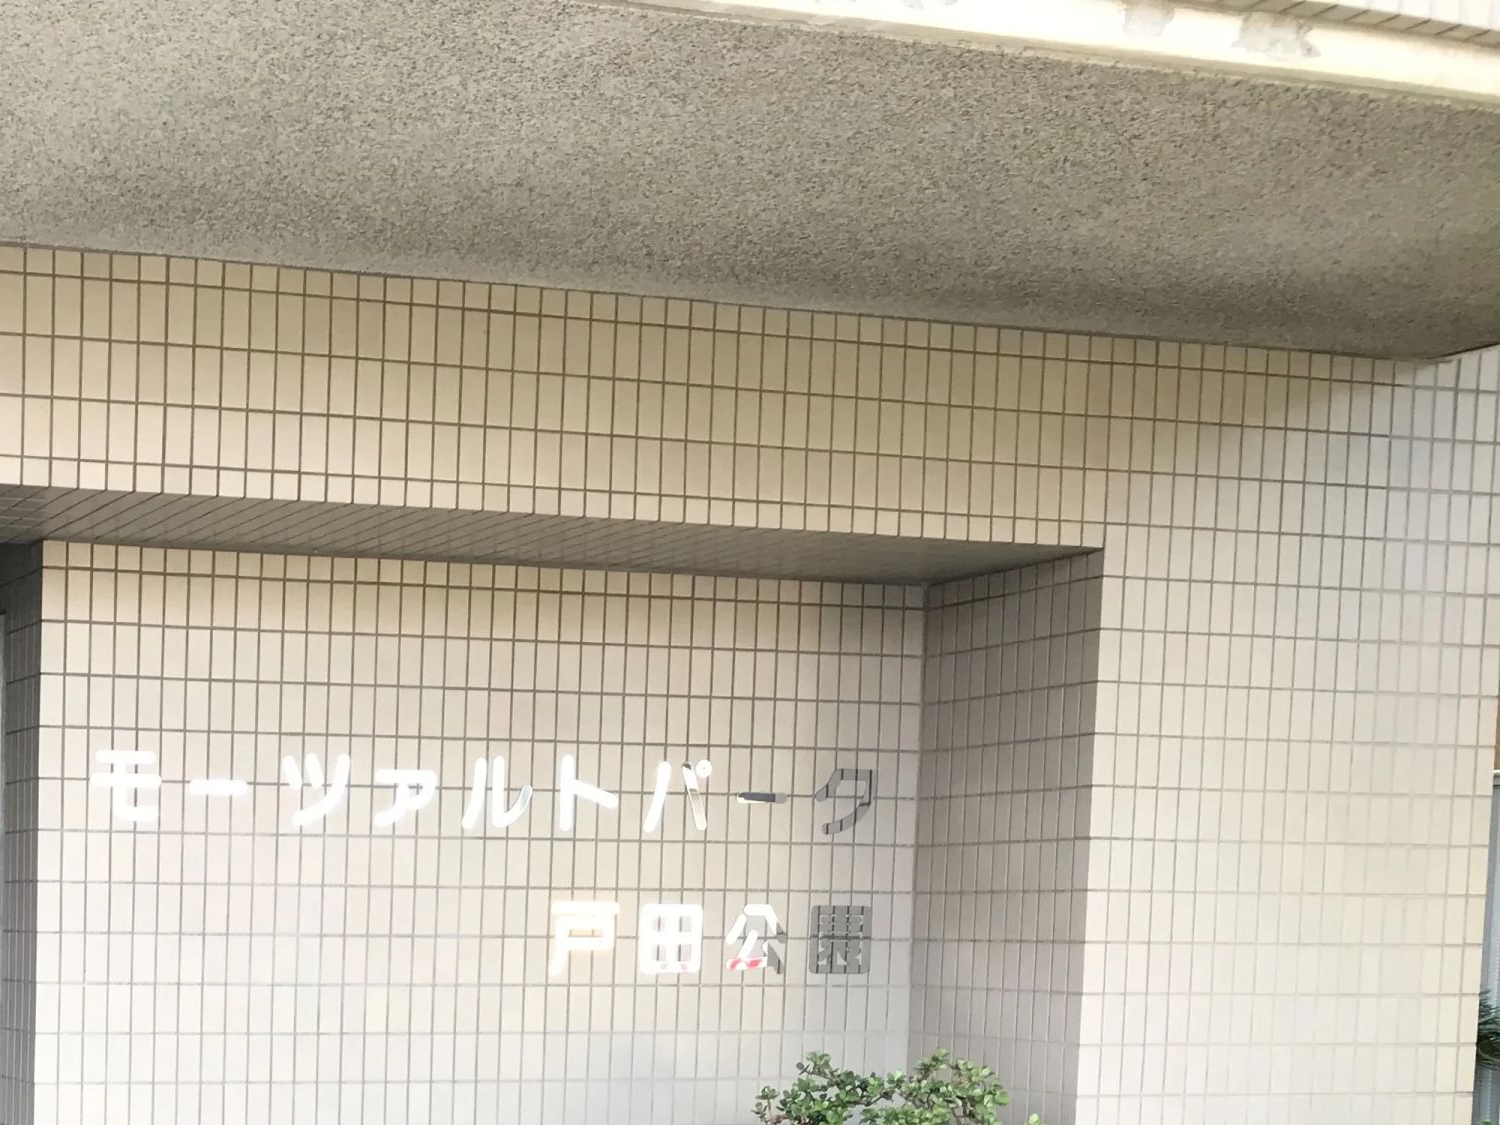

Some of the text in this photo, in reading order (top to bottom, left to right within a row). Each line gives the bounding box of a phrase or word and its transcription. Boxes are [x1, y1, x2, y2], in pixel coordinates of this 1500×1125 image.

[88, 749, 873, 835] モーツァルトパーク
[549, 900, 872, 975] 戸田公園
